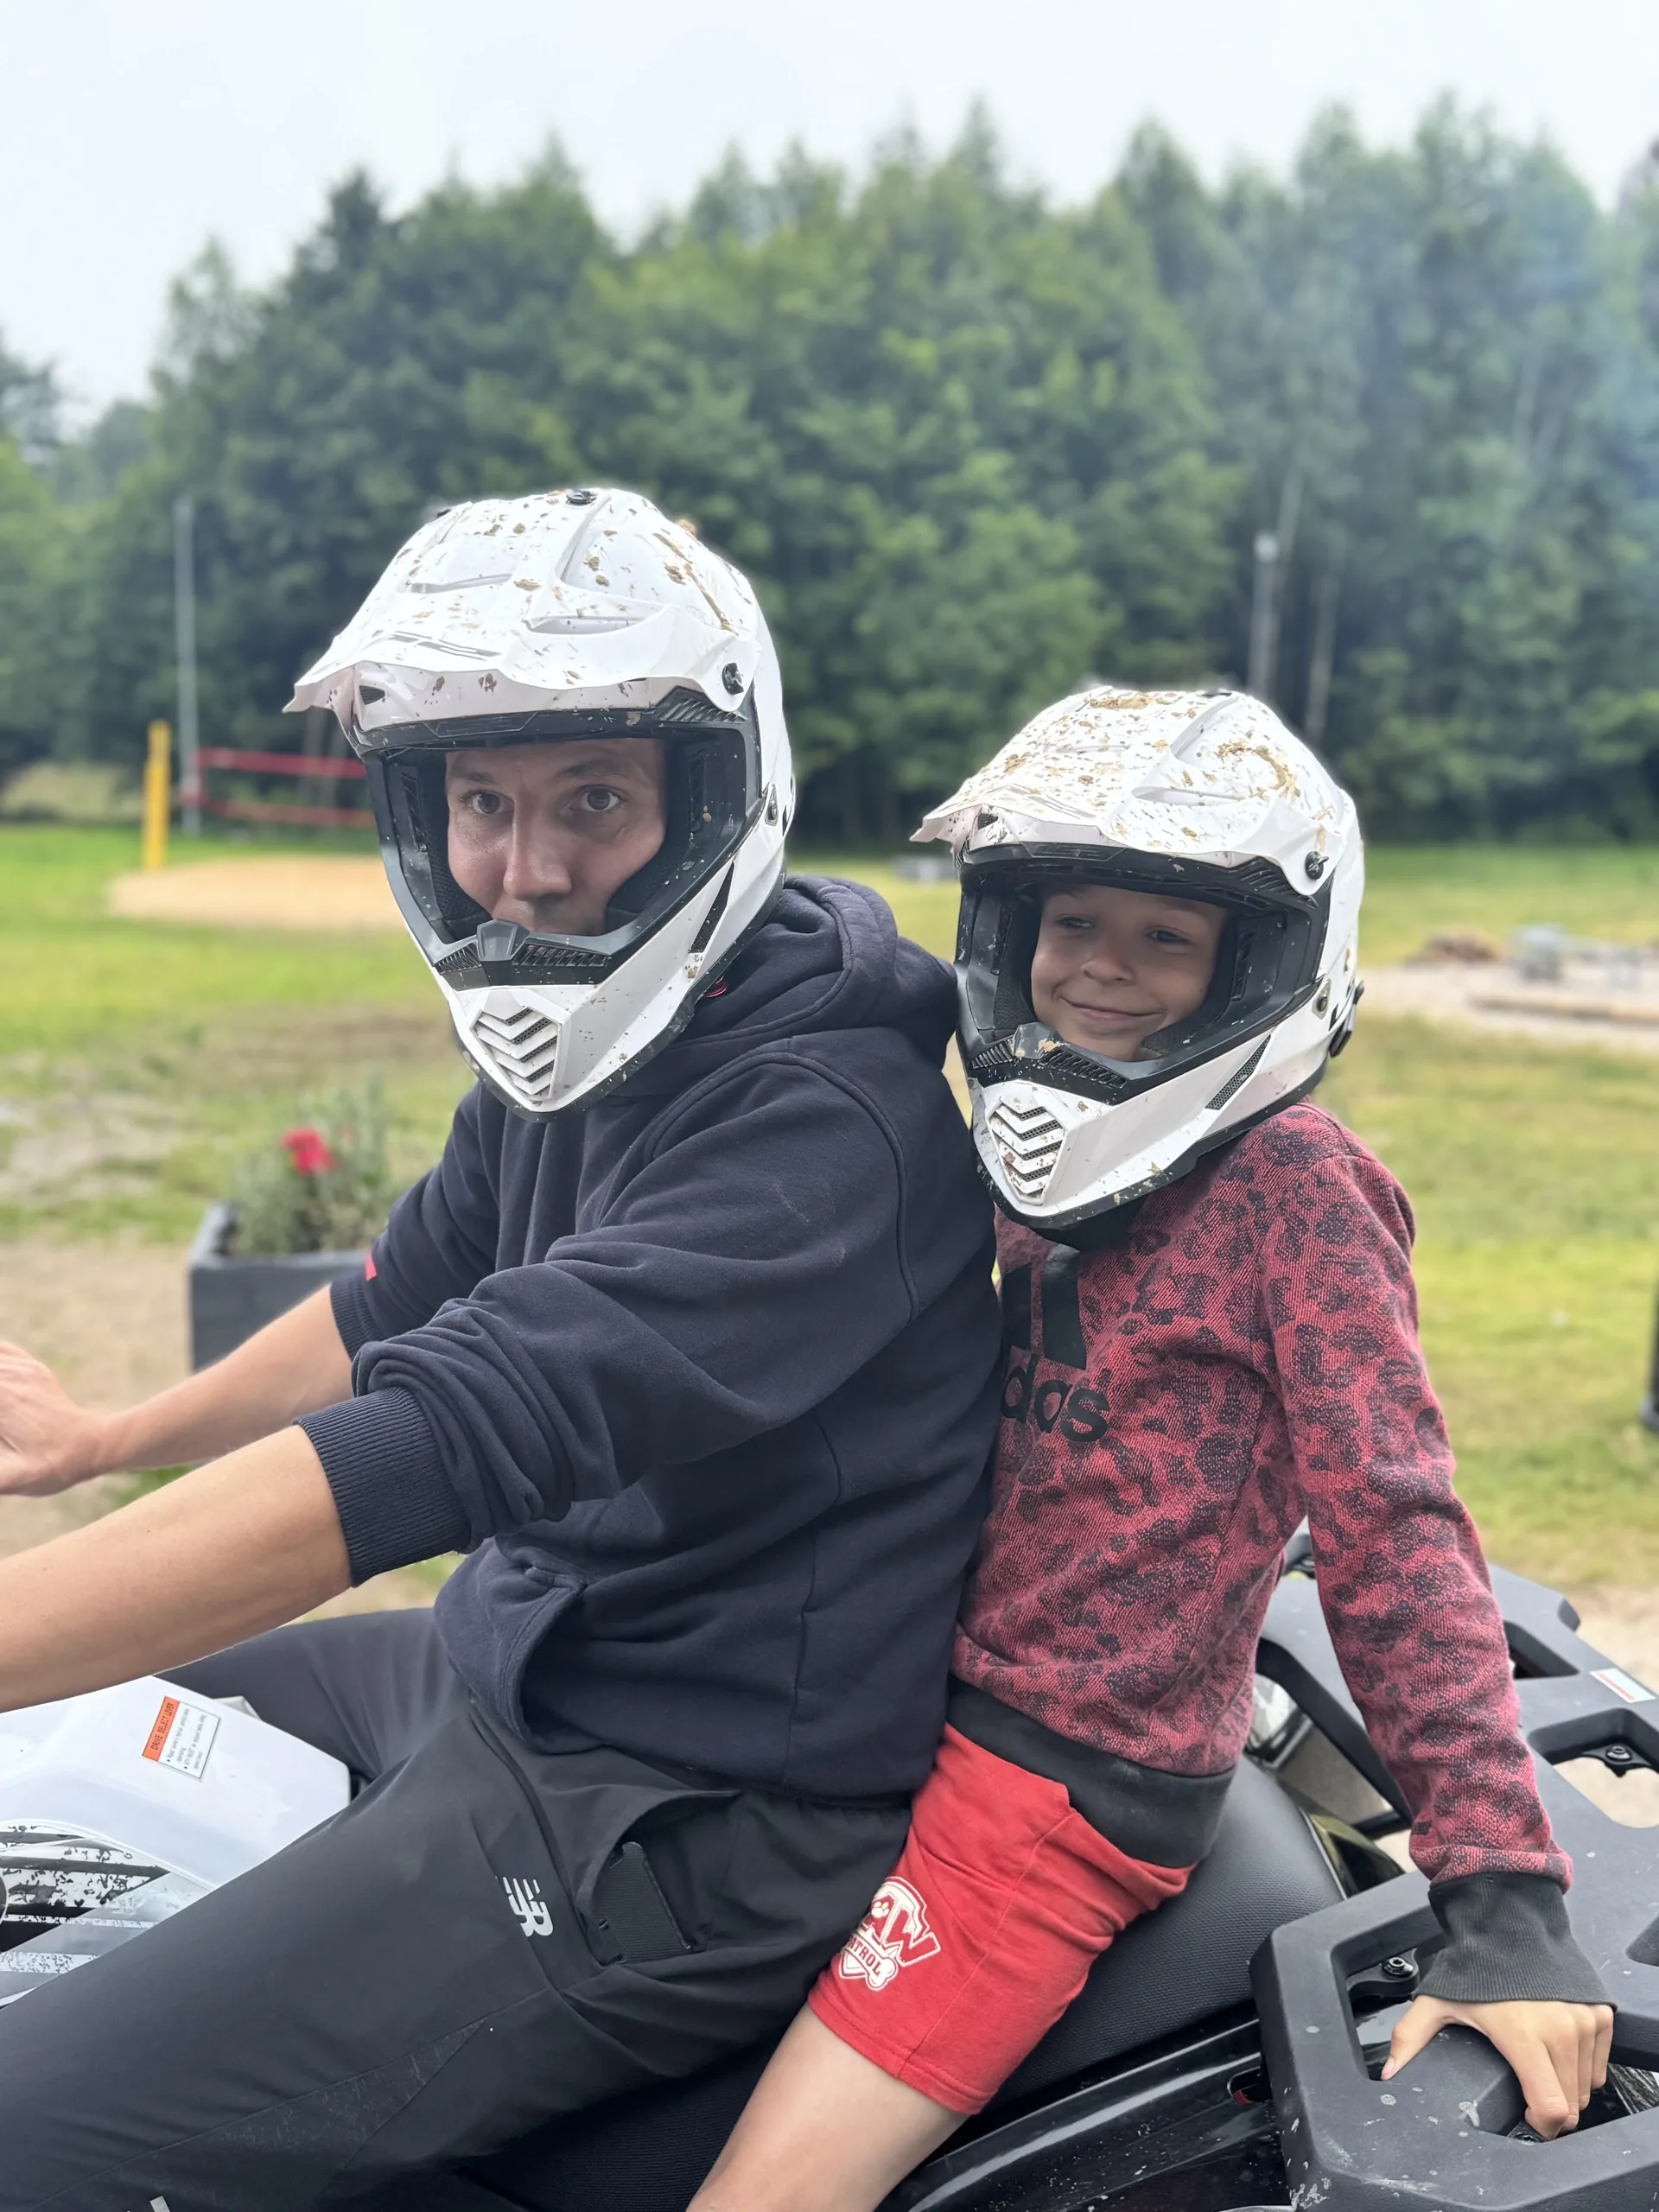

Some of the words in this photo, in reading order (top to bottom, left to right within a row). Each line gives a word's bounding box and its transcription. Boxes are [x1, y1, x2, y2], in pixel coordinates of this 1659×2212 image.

[1000, 1354, 1109, 1442] das
[163, 1701, 175, 1717] LEVER
[156, 1715, 170, 1734] SELECT
[150, 1734, 163, 1751] DRIVE
[860, 1893, 941, 1967] AW
[846, 1939, 881, 1977] ATROL
